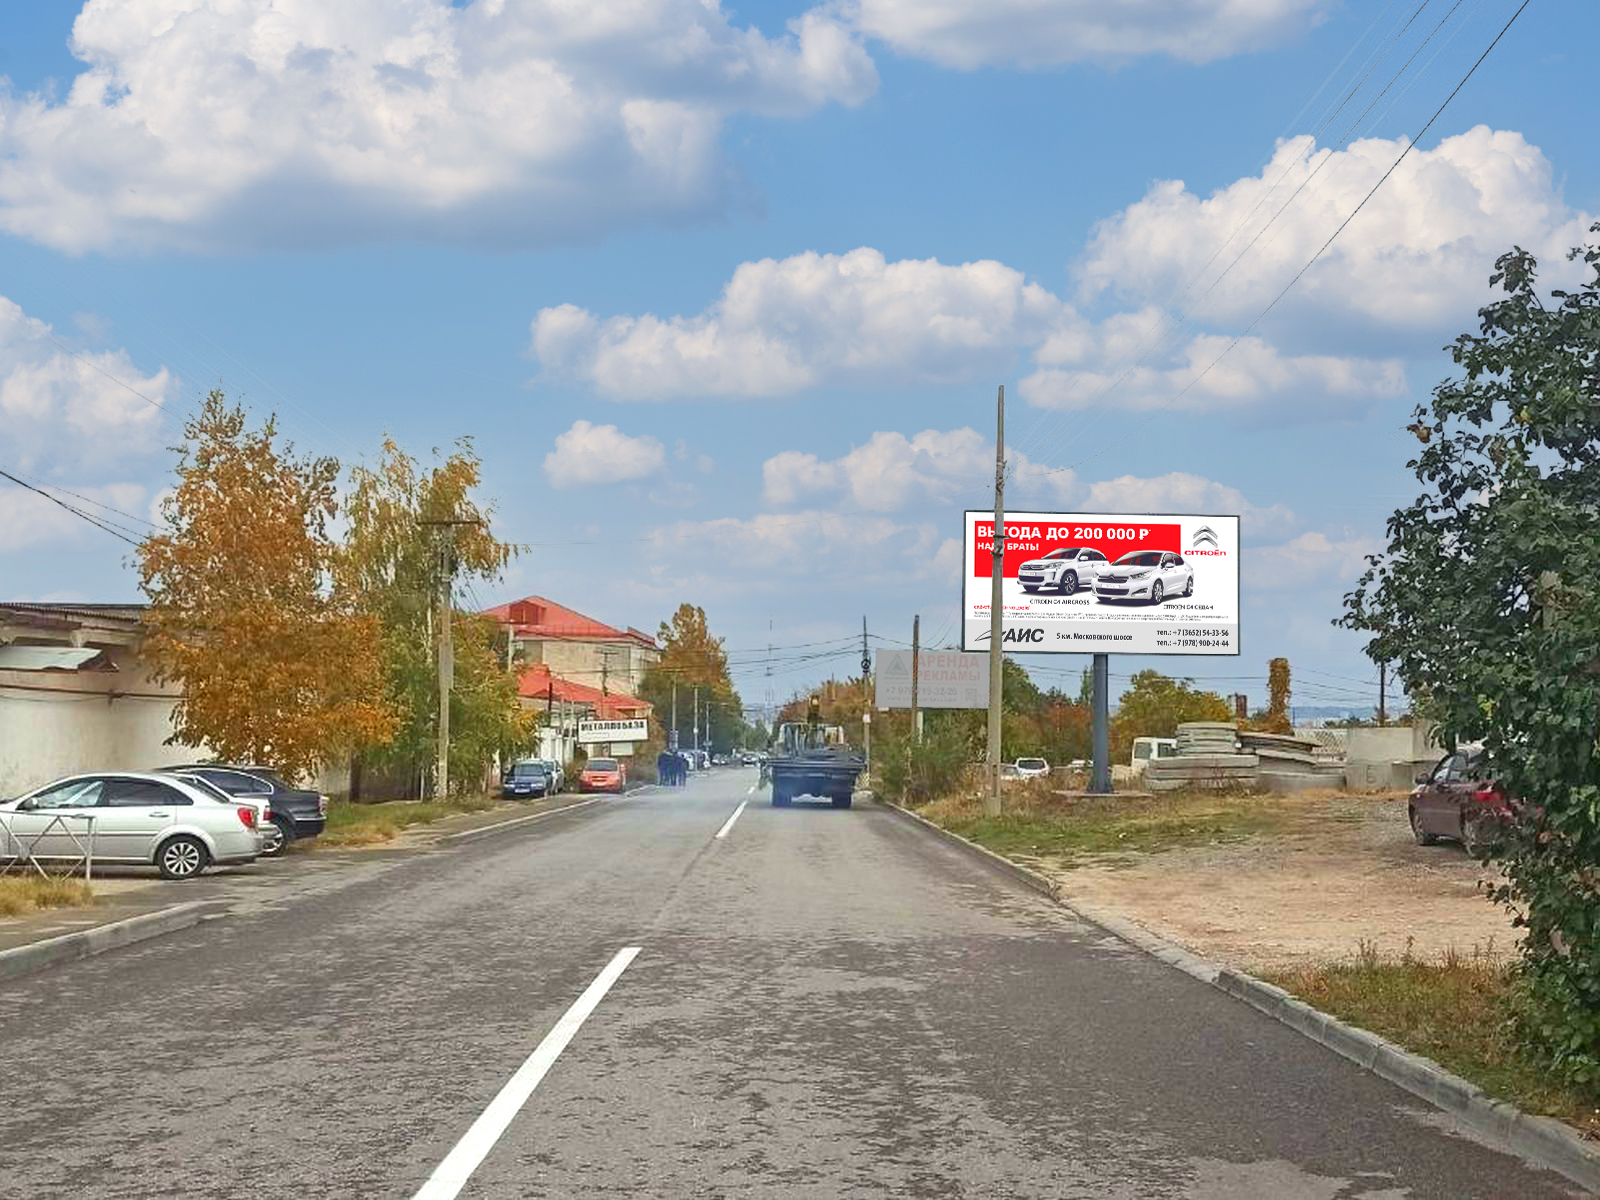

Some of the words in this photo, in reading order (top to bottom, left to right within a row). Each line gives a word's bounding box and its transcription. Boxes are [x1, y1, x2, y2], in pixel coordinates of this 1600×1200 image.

[978, 526, 1041, 540] ВОДА
[1046, 527, 1069, 540] ДО
[1074, 527, 1102, 539] 200
[1107, 528, 1135, 540] 000
[1007, 543, 1039, 551] БРАТЬ!
[1003, 628, 1044, 642] АИС
[1056, 632, 1060, 640] 5
[1073, 632, 1112, 640] Московского
[1182, 629, 1201, 637] (3652)
[917, 655, 980, 669] АРЕНДА
